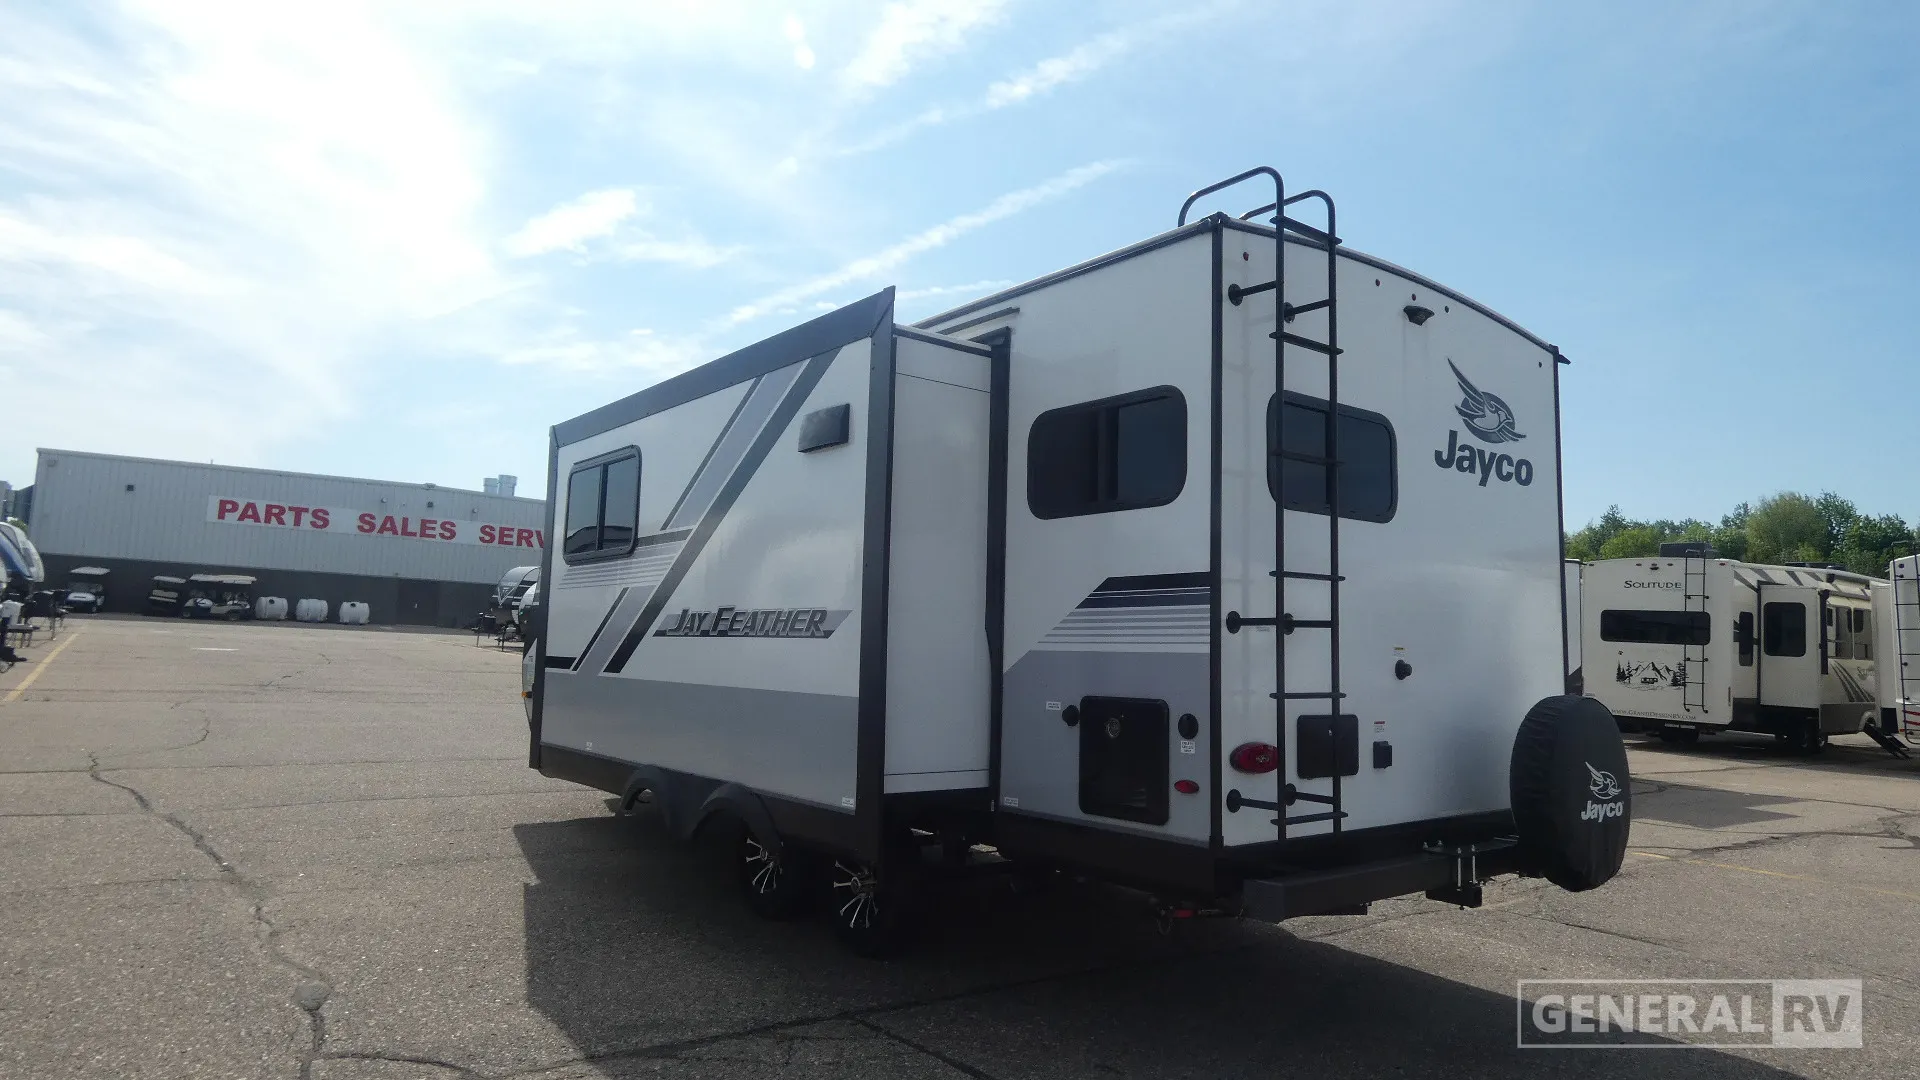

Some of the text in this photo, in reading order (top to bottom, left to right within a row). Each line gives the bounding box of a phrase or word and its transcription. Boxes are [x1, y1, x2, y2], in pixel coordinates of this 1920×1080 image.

[1434, 429, 1534, 487] Jayco
[217, 499, 330, 529] PARTS
[357, 512, 457, 541] SALES
[667, 605, 828, 637] JAY FEATHER
[1581, 800, 1623, 823] Jayco
